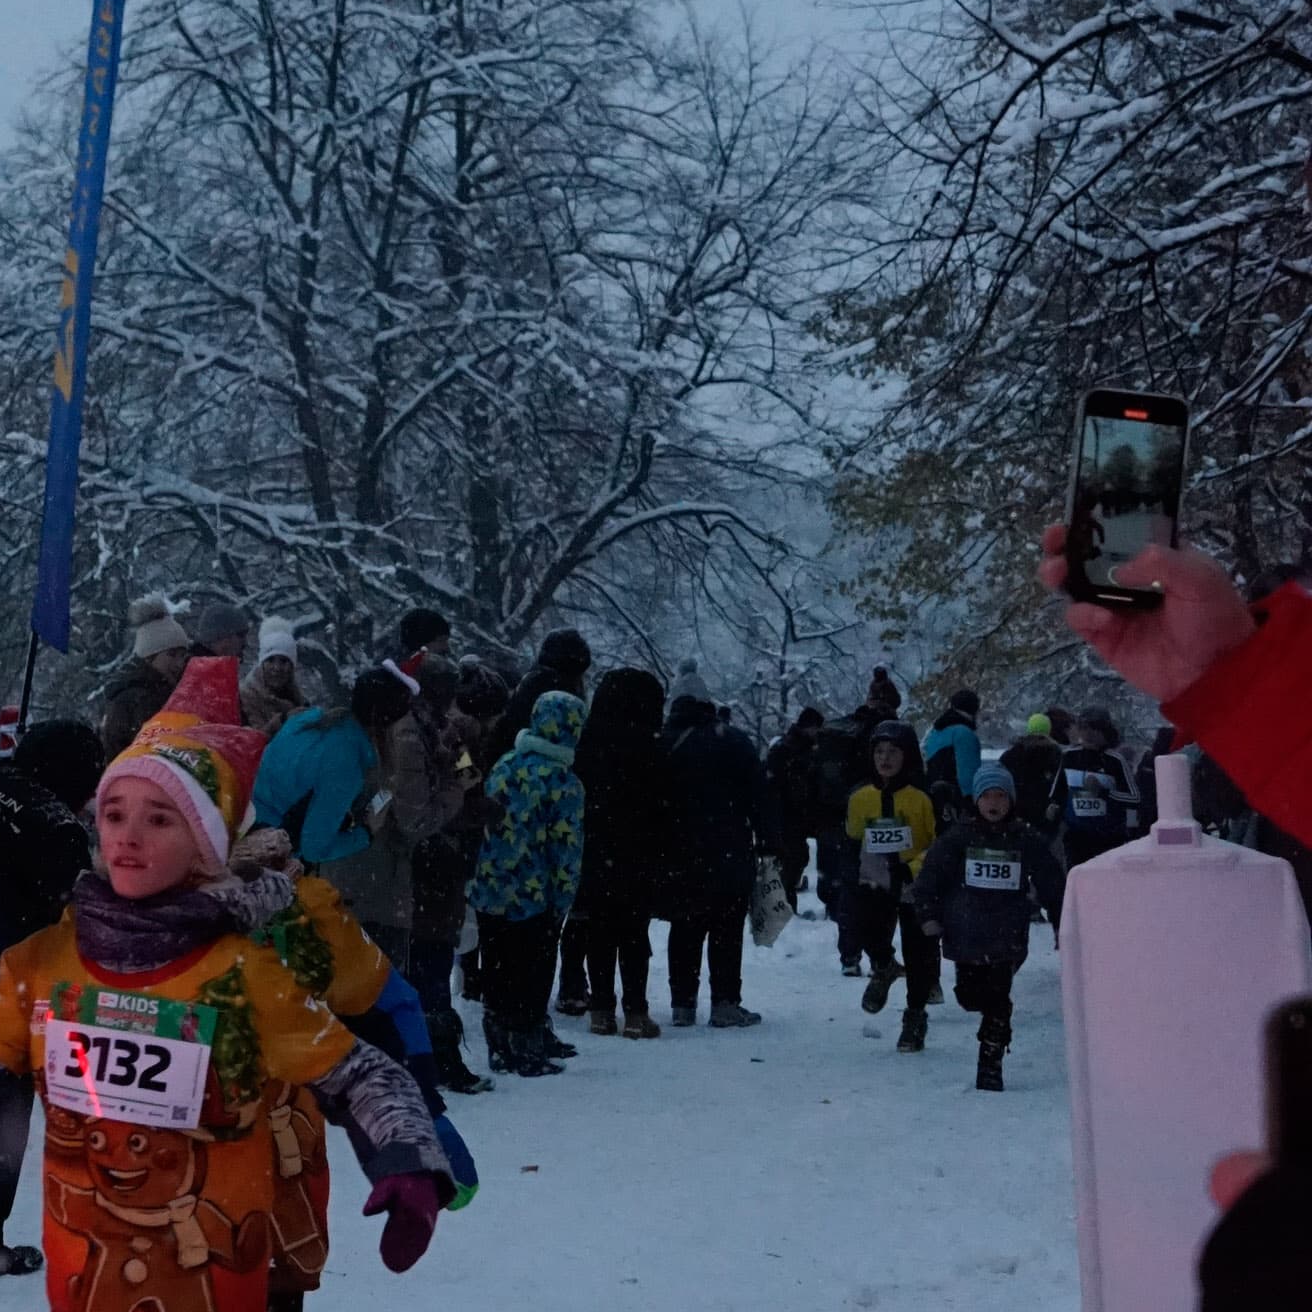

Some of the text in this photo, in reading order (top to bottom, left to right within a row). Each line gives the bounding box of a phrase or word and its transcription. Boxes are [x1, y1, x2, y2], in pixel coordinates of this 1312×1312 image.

[870, 829, 904, 845] 3225
[973, 861, 1011, 880] 3138
[118, 993, 160, 1015] KIDS
[64, 1031, 171, 1093] 3132
